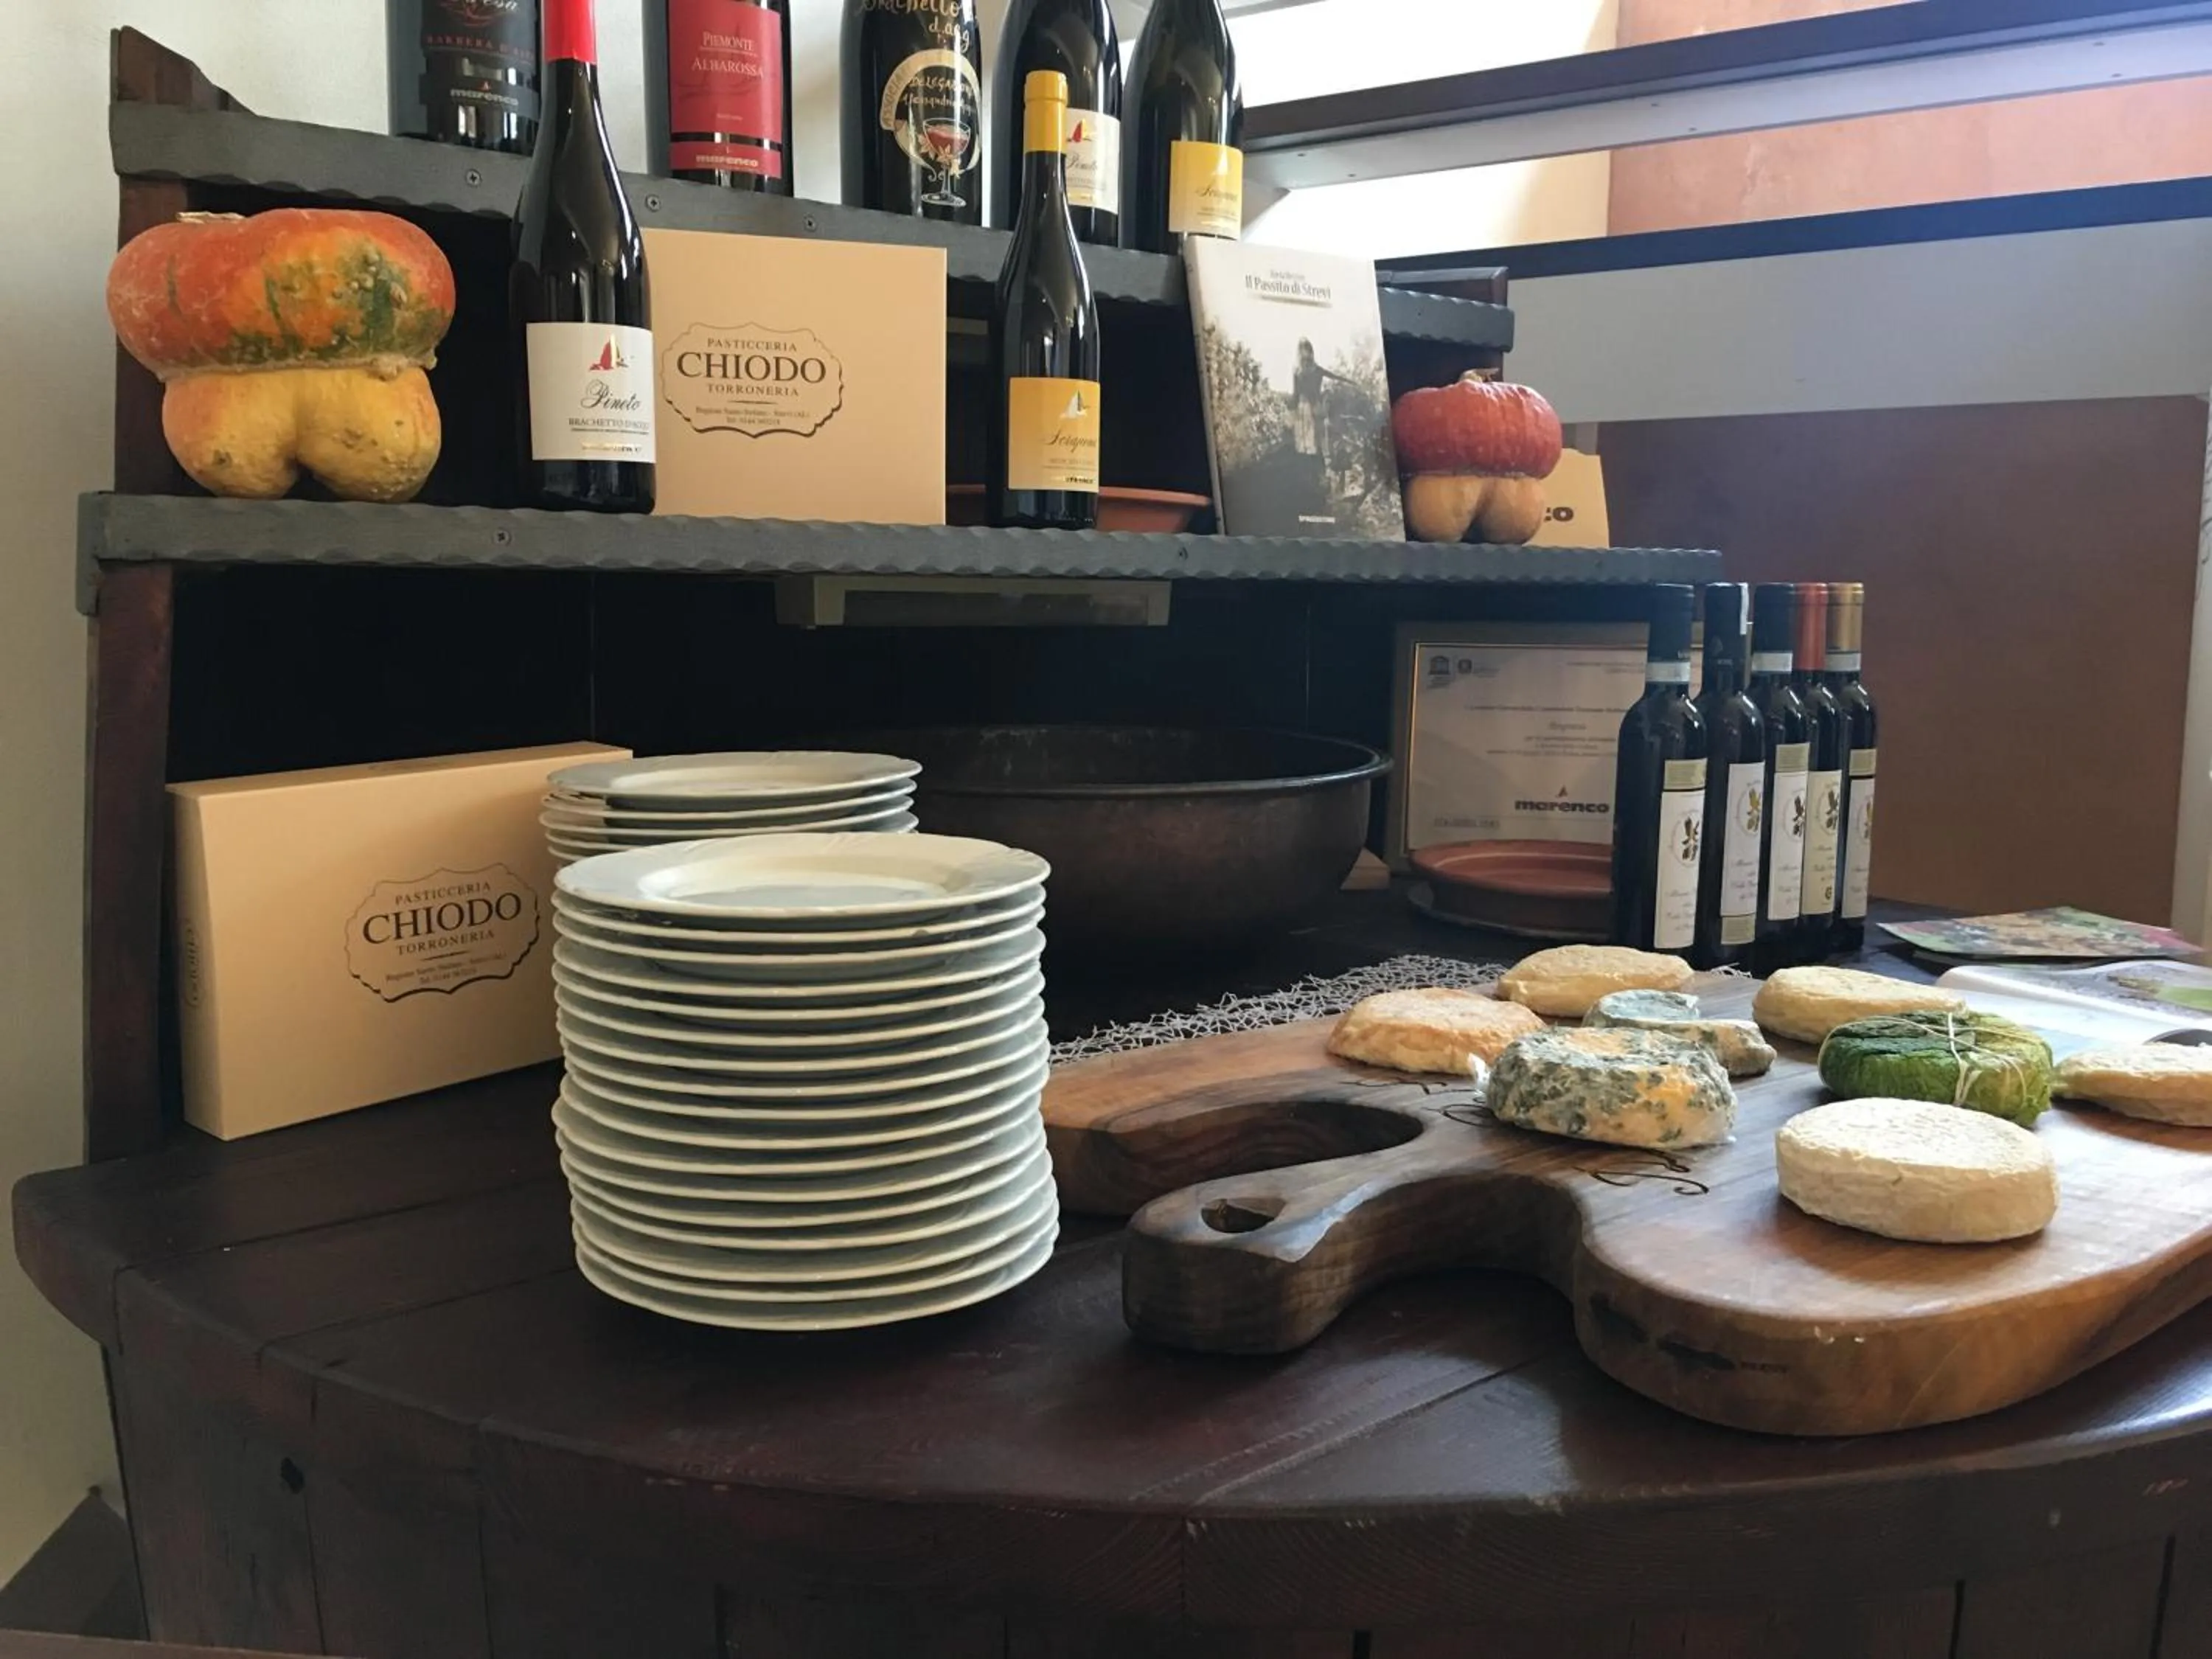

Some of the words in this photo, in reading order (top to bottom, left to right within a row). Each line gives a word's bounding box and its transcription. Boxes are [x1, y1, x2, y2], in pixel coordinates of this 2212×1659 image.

[702, 32, 757, 52] PIEMONTE
[692, 58, 764, 80] ALBAROSSA
[1253, 276, 1290, 293] Passito
[707, 337, 798, 352] PASTICCERIA
[677, 352, 827, 384] CHIODO
[707, 383, 799, 397] TORRONERIA
[1514, 800, 1610, 814] marenco
[395, 882, 491, 906] PASTICCERIA
[362, 892, 521, 945] CHIODO
[397, 929, 495, 956] TORRONERIA
